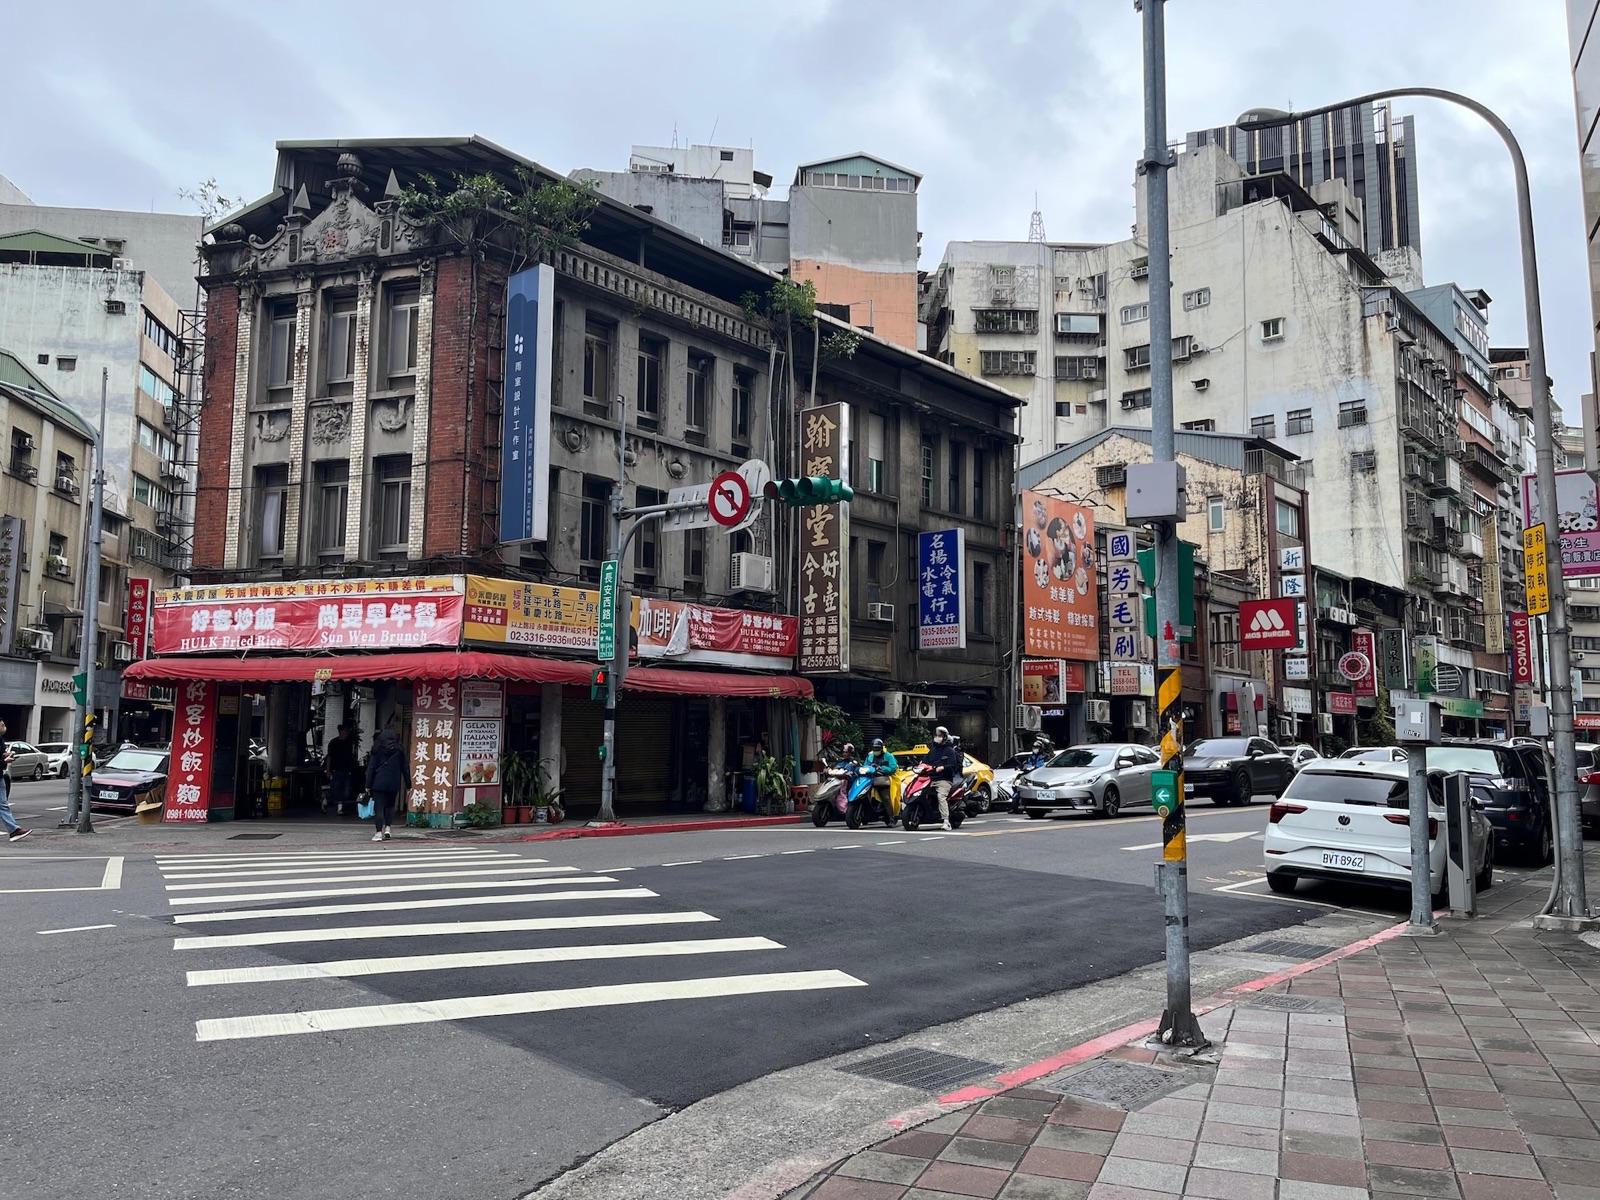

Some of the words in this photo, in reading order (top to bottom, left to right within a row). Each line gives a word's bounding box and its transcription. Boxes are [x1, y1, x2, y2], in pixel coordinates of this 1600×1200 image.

[1560, 536, 1588, 550] 先生
[921, 566, 938, 598] 水電
[940, 564, 957, 596] 冷氣
[1525, 533, 1538, 611] 違停取締
[1535, 529, 1548, 609] 科技執法
[172, 589, 218, 602] 永慶房屋
[225, 585, 298, 599] 先誠實再成交
[304, 582, 367, 596] 堅持不炒房
[375, 579, 427, 592] 不賺差價
[602, 572, 613, 621] 長安西路
[1110, 533, 1134, 659] 國芳毛刷
[191, 606, 276, 633] 好客炒飯
[317, 601, 438, 630] 尚雯早午餐
[930, 597, 948, 613] 行
[740, 628, 760, 637] HULK
[760, 630, 776, 639] Fried
[776, 632, 789, 640] Rice
[742, 613, 783, 631] 好客炒飯
[1244, 632, 1262, 640] MOS
[1262, 630, 1291, 639] BURGER
[180, 636, 220, 650] HULK
[222, 635, 255, 649] Fried
[257, 634, 283, 647] Rice
[320, 630, 344, 644] Sun
[348, 629, 376, 643] Wen
[380, 629, 428, 643] Brunch
[807, 654, 840, 668] 2556-2613
[1516, 630, 1529, 677] KYMCO
[416, 682, 456, 711] 尚雯
[465, 722, 496, 730] GELATO
[411, 717, 433, 808] 蔬菜蛋餅
[432, 719, 454, 811] 鍋貼飲料
[465, 752, 494, 760] ARJAN
[1322, 853, 1364, 868] BVT-8962
